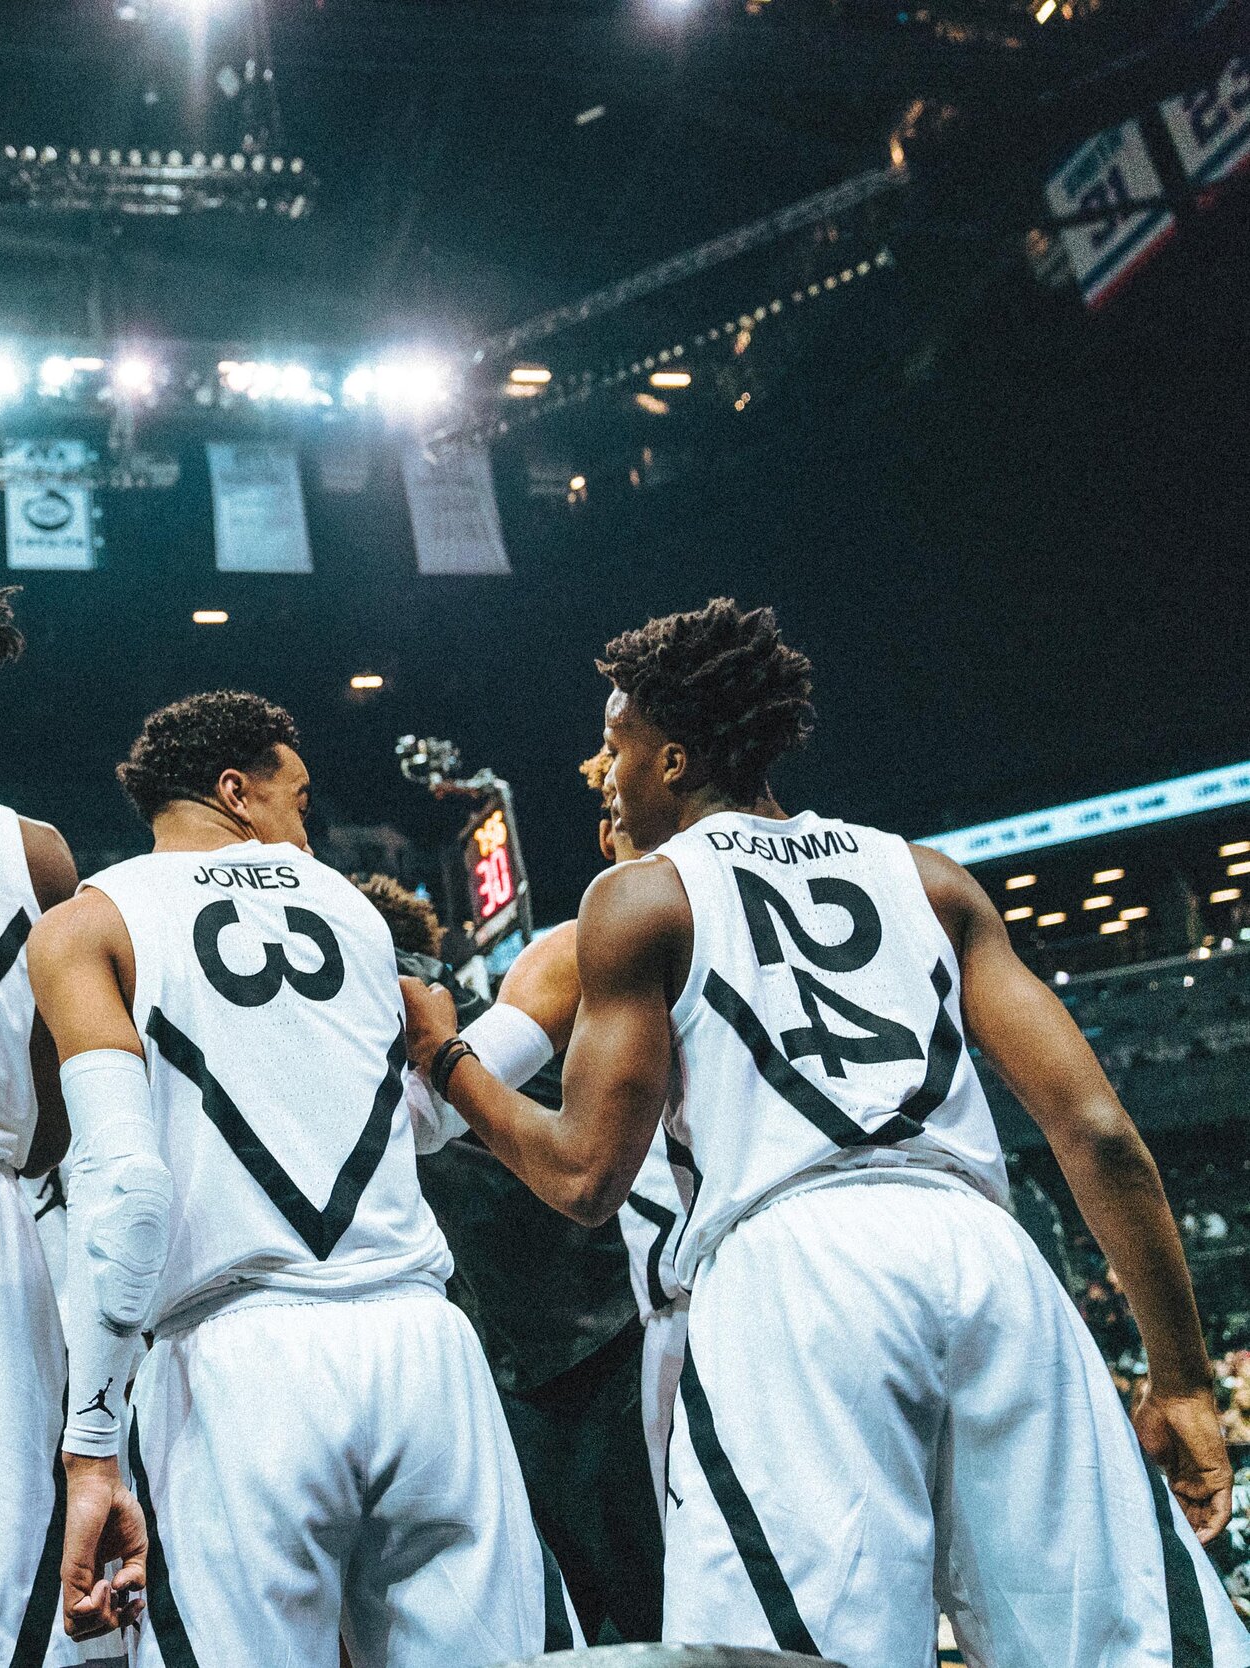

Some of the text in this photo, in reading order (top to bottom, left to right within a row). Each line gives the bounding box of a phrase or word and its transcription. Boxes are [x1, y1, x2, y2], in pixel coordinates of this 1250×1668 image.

[193, 865, 301, 890] JONES
[705, 831, 860, 864] DOSUNMU
[193, 899, 345, 1008] 3
[732, 865, 926, 1079] 24
